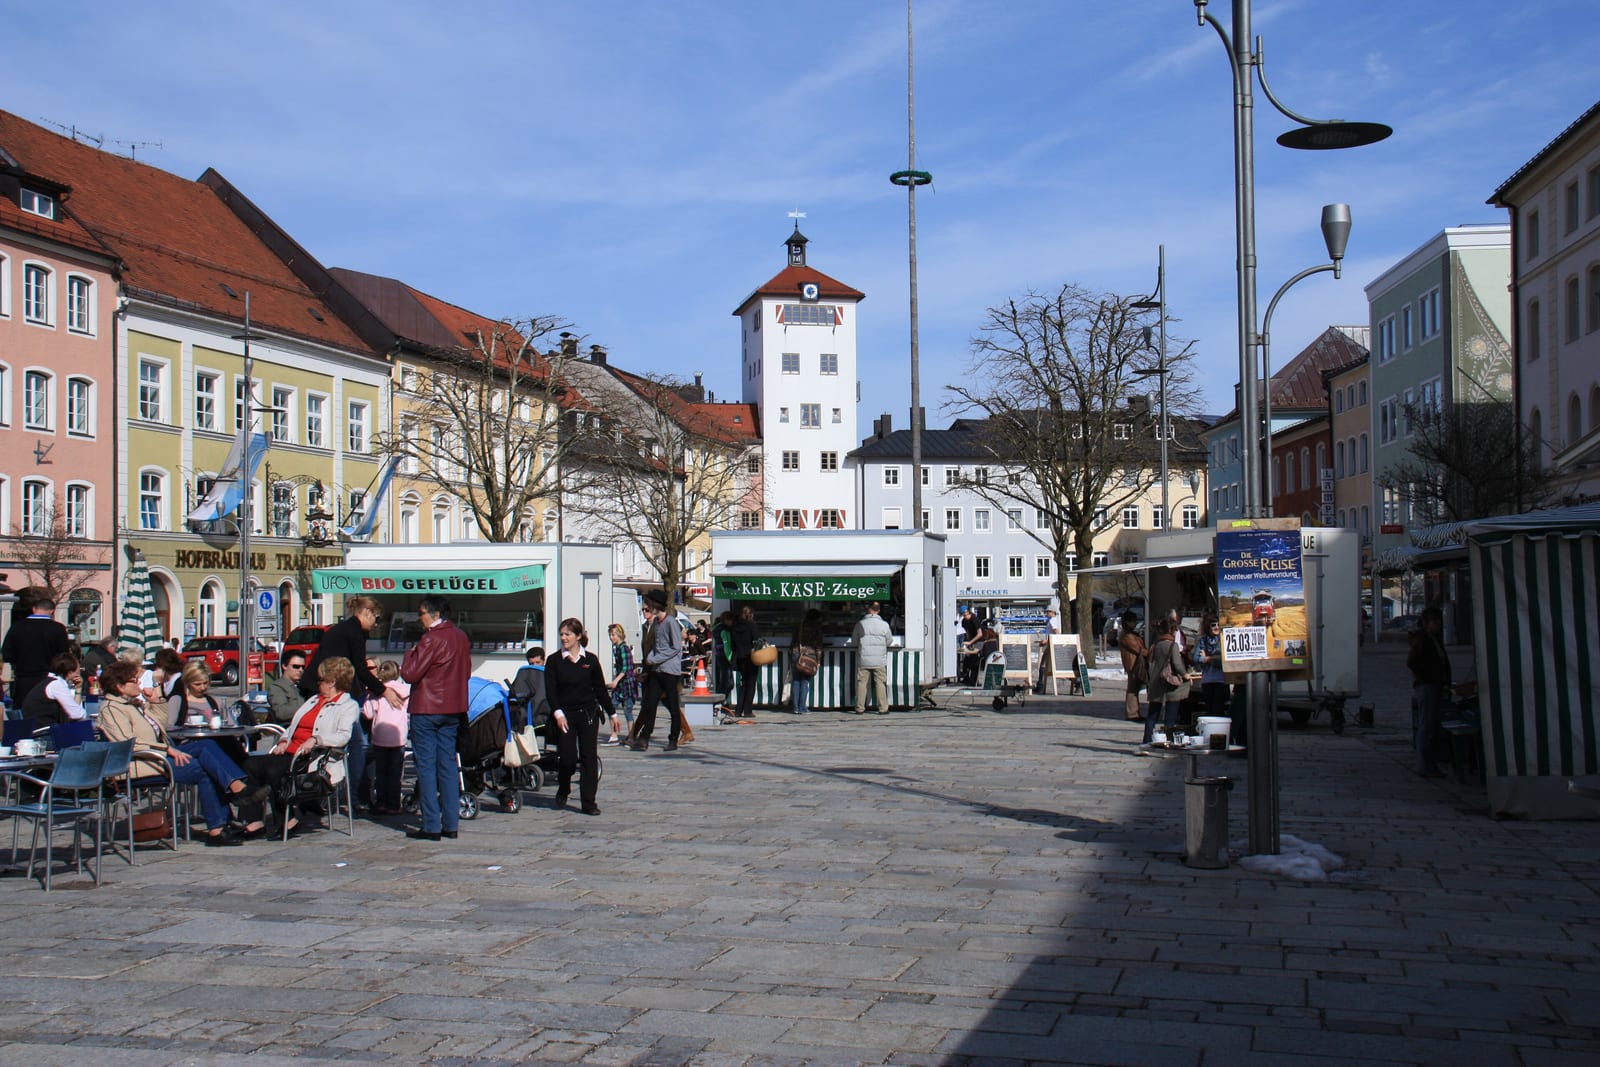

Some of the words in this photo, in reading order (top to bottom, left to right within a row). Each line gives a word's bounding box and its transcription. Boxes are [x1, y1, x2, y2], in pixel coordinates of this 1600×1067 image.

[1223, 559, 1259, 569] GROSSE
[1261, 558, 1297, 571] REISE
[361, 578, 396, 590] BIO
[402, 576, 498, 591] GEFLÜGEL
[1224, 573, 1252, 581] Abenteuer
[742, 582, 771, 596] Kuh
[780, 581, 826, 598] KÄSE
[832, 583, 875, 599] Ziege
